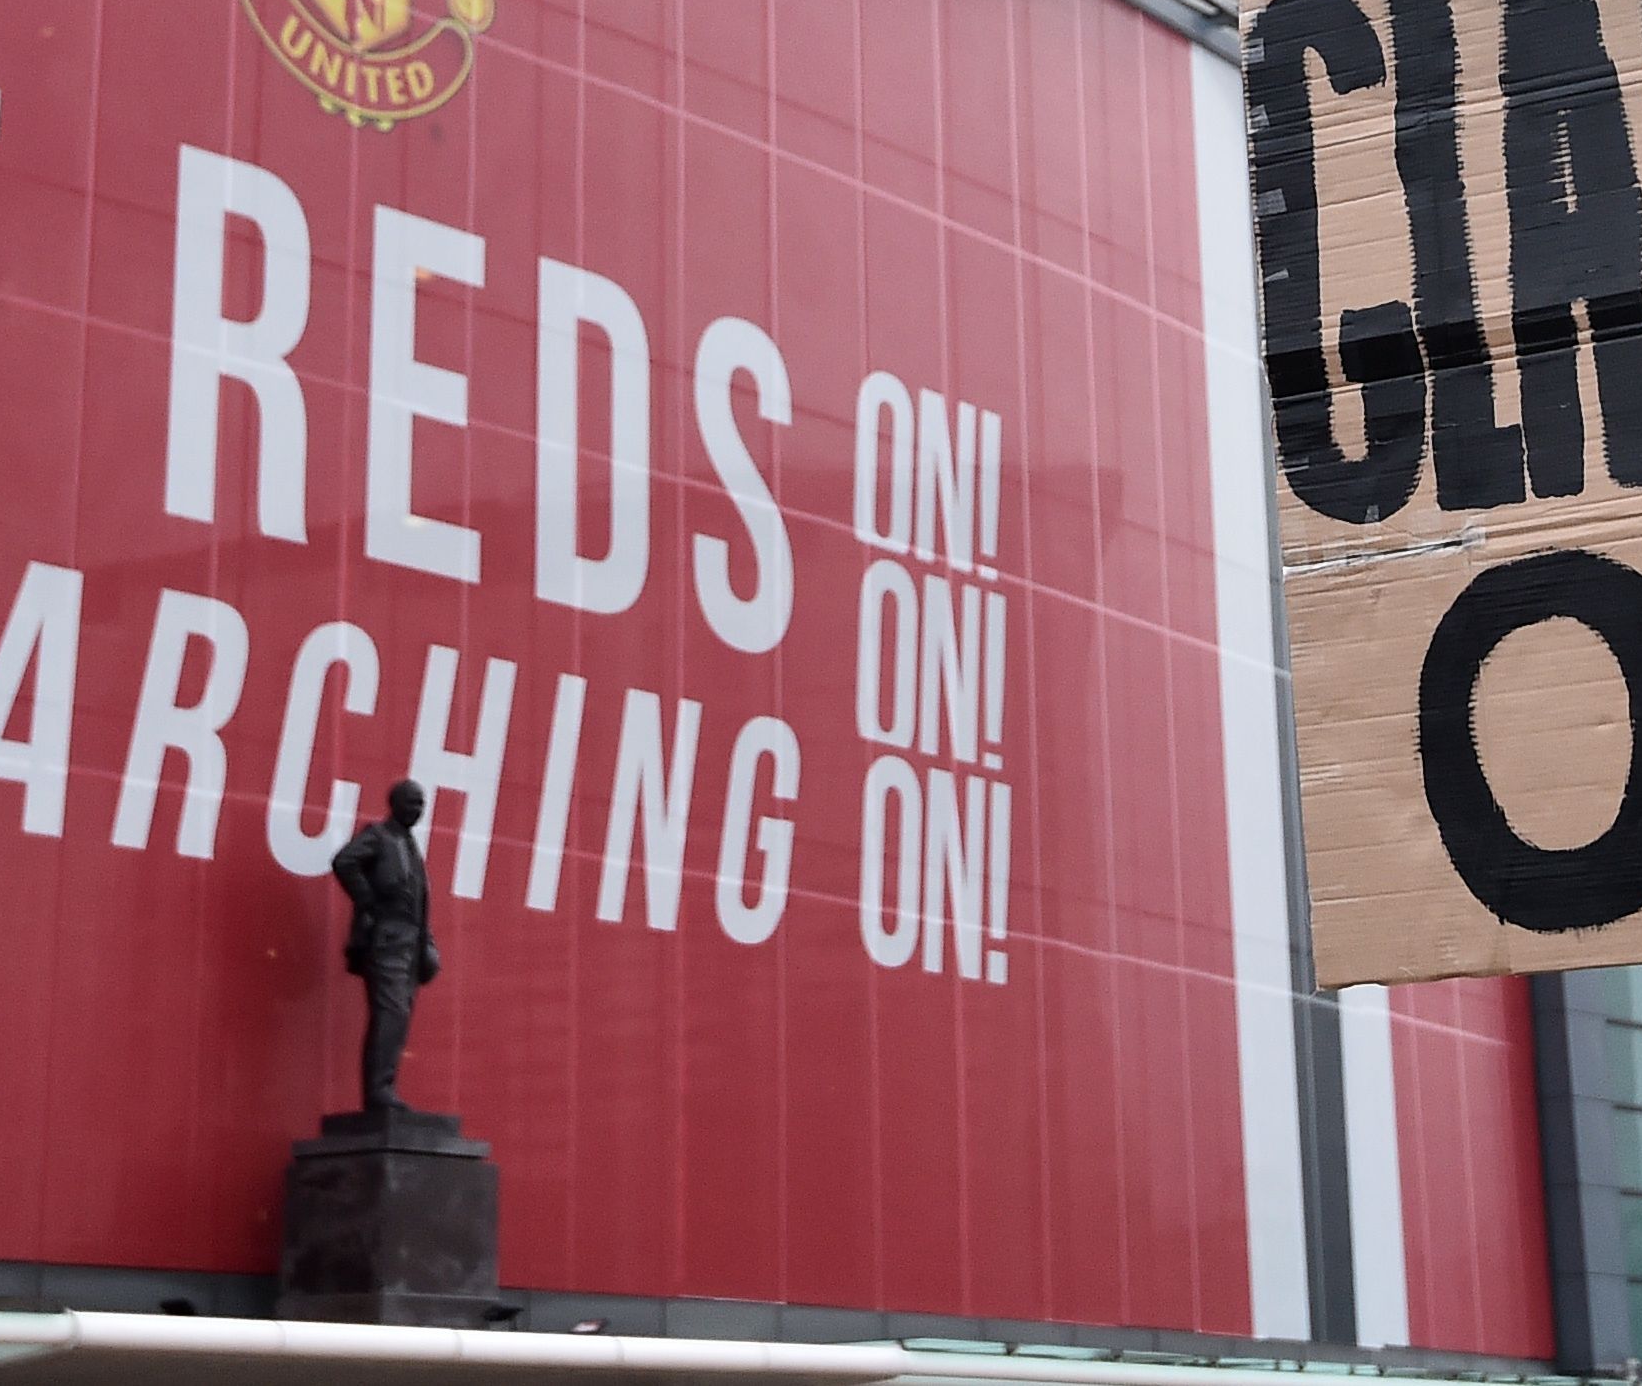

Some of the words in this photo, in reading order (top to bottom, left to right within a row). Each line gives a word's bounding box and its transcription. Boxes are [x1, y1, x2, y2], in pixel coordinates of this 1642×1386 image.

[279, 15, 435, 105] UNITED
[164, 144, 795, 654] REDS
[853, 369, 1002, 580] ON!
[855, 558, 1007, 770] ON!
[859, 754, 1012, 986] ON!
